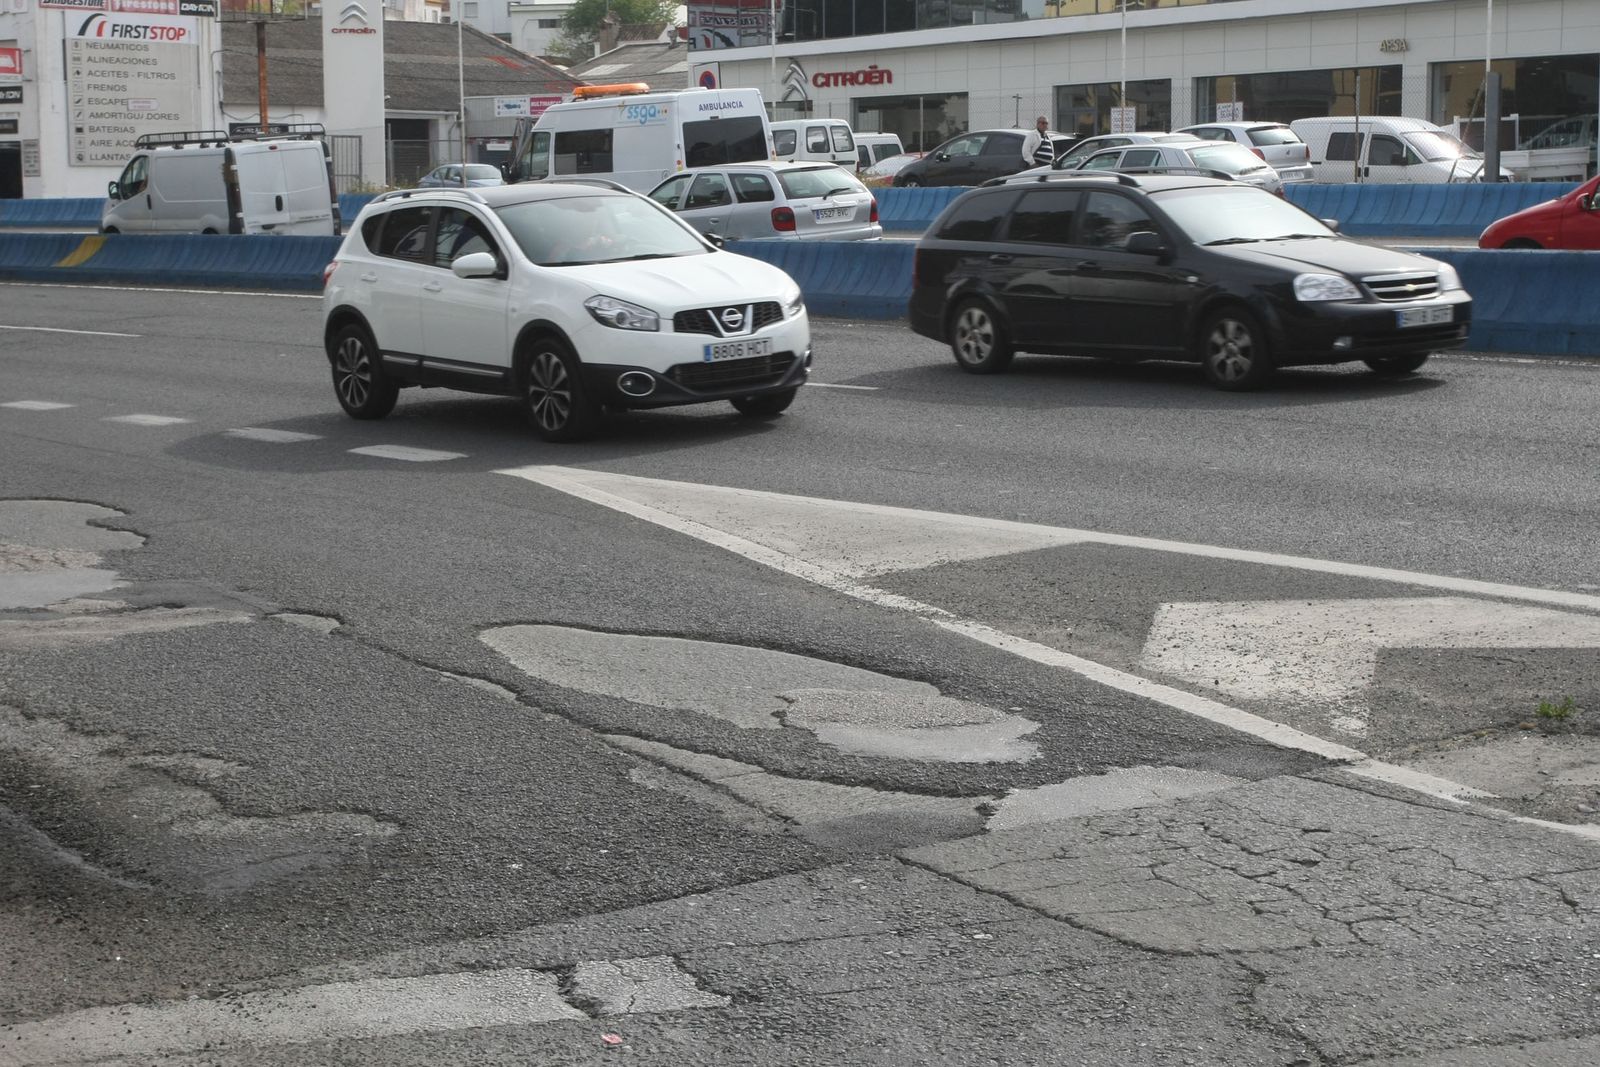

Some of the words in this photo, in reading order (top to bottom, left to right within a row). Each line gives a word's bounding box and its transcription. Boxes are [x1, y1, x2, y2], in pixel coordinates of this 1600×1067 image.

[86, 42, 150, 52] NEUMATICOS
[87, 56, 158, 66] ALINEACIONES
[87, 70, 129, 78] ACEITES
[137, 71, 176, 80] FILTROS
[87, 83, 128, 92] FRENOS
[698, 101, 744, 112] AMBULANCIA
[88, 125, 136, 134] BATERIAS
[89, 139, 113, 147] AIRE
